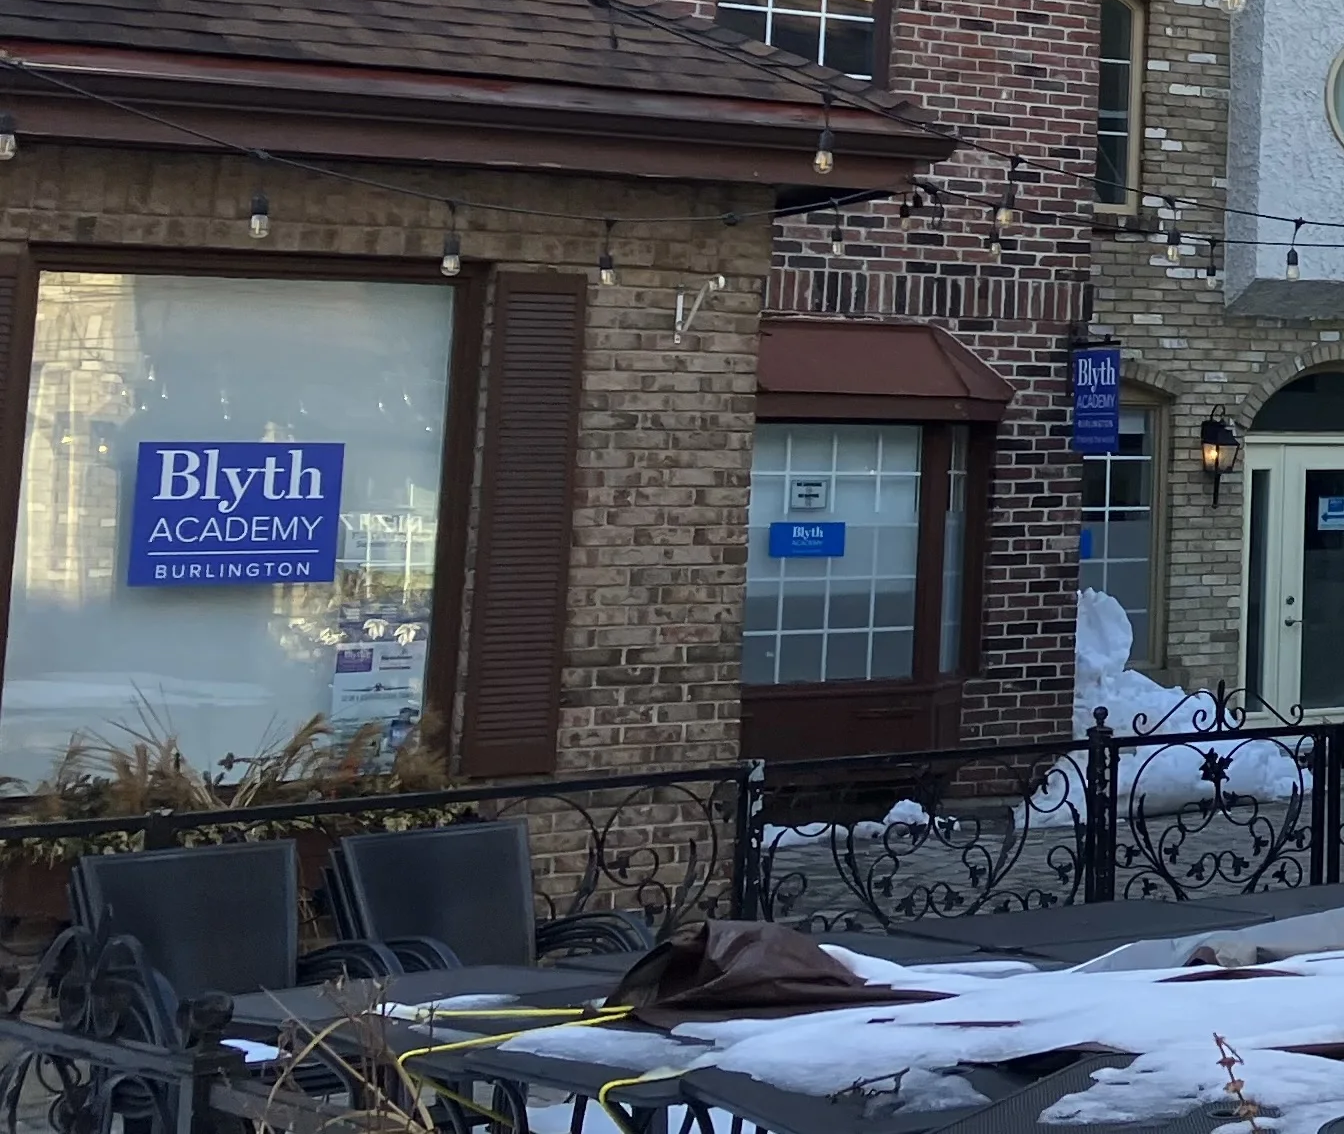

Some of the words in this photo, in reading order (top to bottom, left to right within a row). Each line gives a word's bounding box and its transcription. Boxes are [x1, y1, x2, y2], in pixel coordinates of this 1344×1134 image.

[1076, 356, 1117, 394] Blyth
[1076, 393, 1116, 409] ACADEMY
[152, 448, 325, 514] Blyth
[148, 516, 324, 543] ACADEMY
[792, 525, 824, 541] Blyth
[154, 561, 311, 579] BURLINGTON
